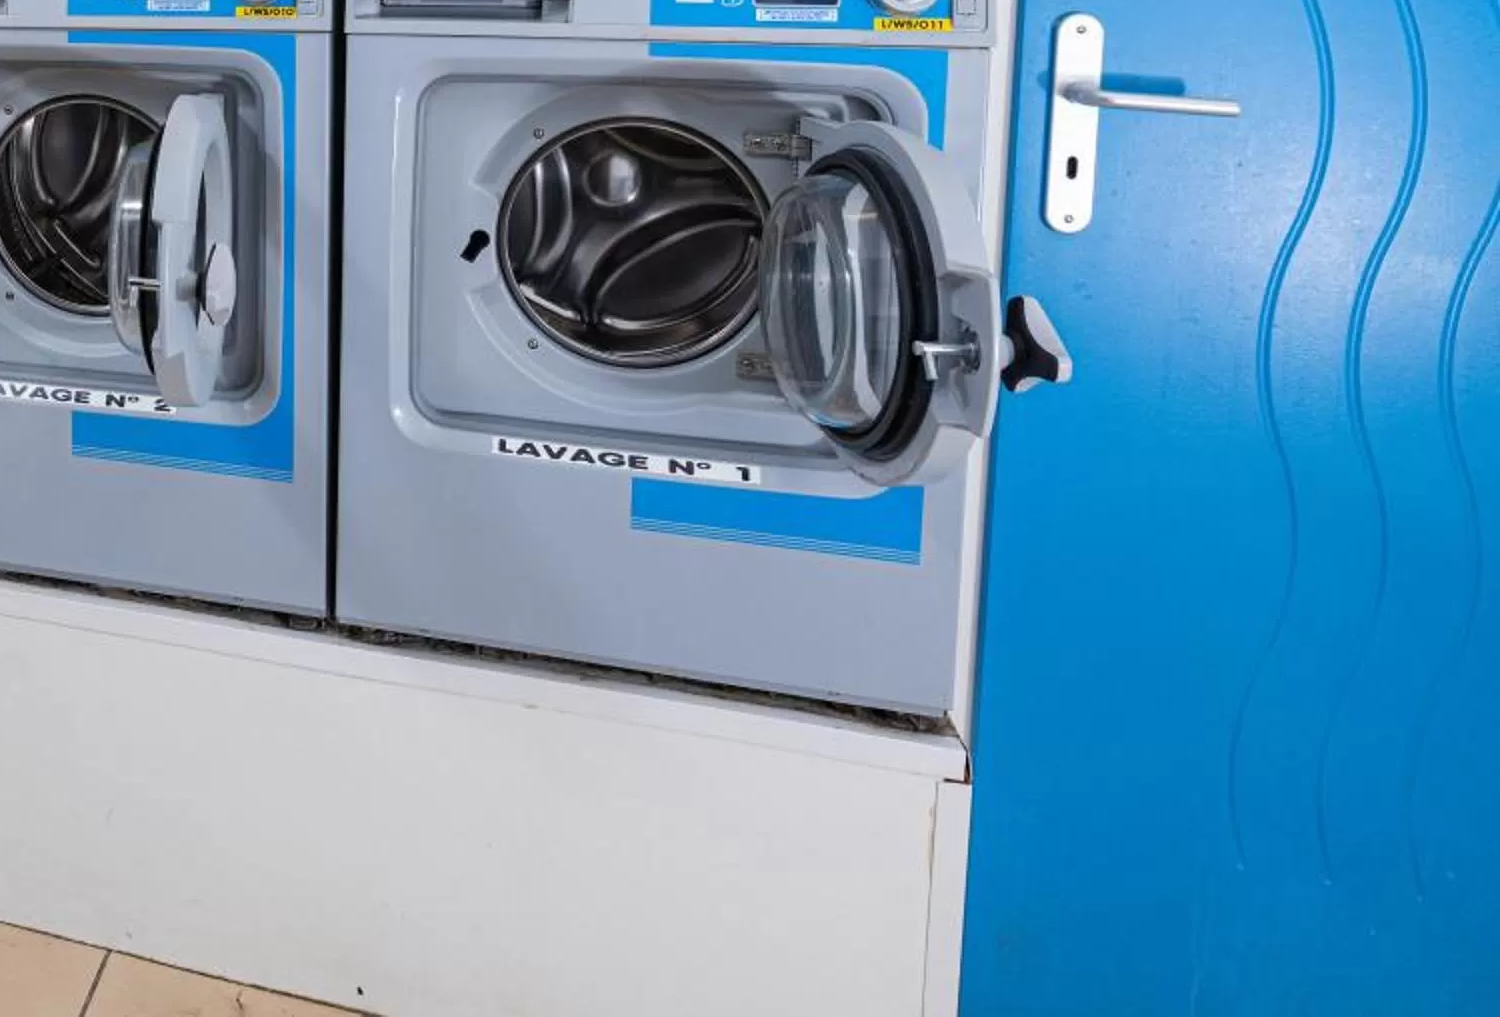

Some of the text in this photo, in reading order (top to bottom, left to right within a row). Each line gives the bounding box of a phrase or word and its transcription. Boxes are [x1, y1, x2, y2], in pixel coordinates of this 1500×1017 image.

[880, 20, 945, 30] L/WS/011
[153, 397, 171, 412] 2
[498, 438, 650, 470] LAVAGE
[736, 465, 751, 482] 1
